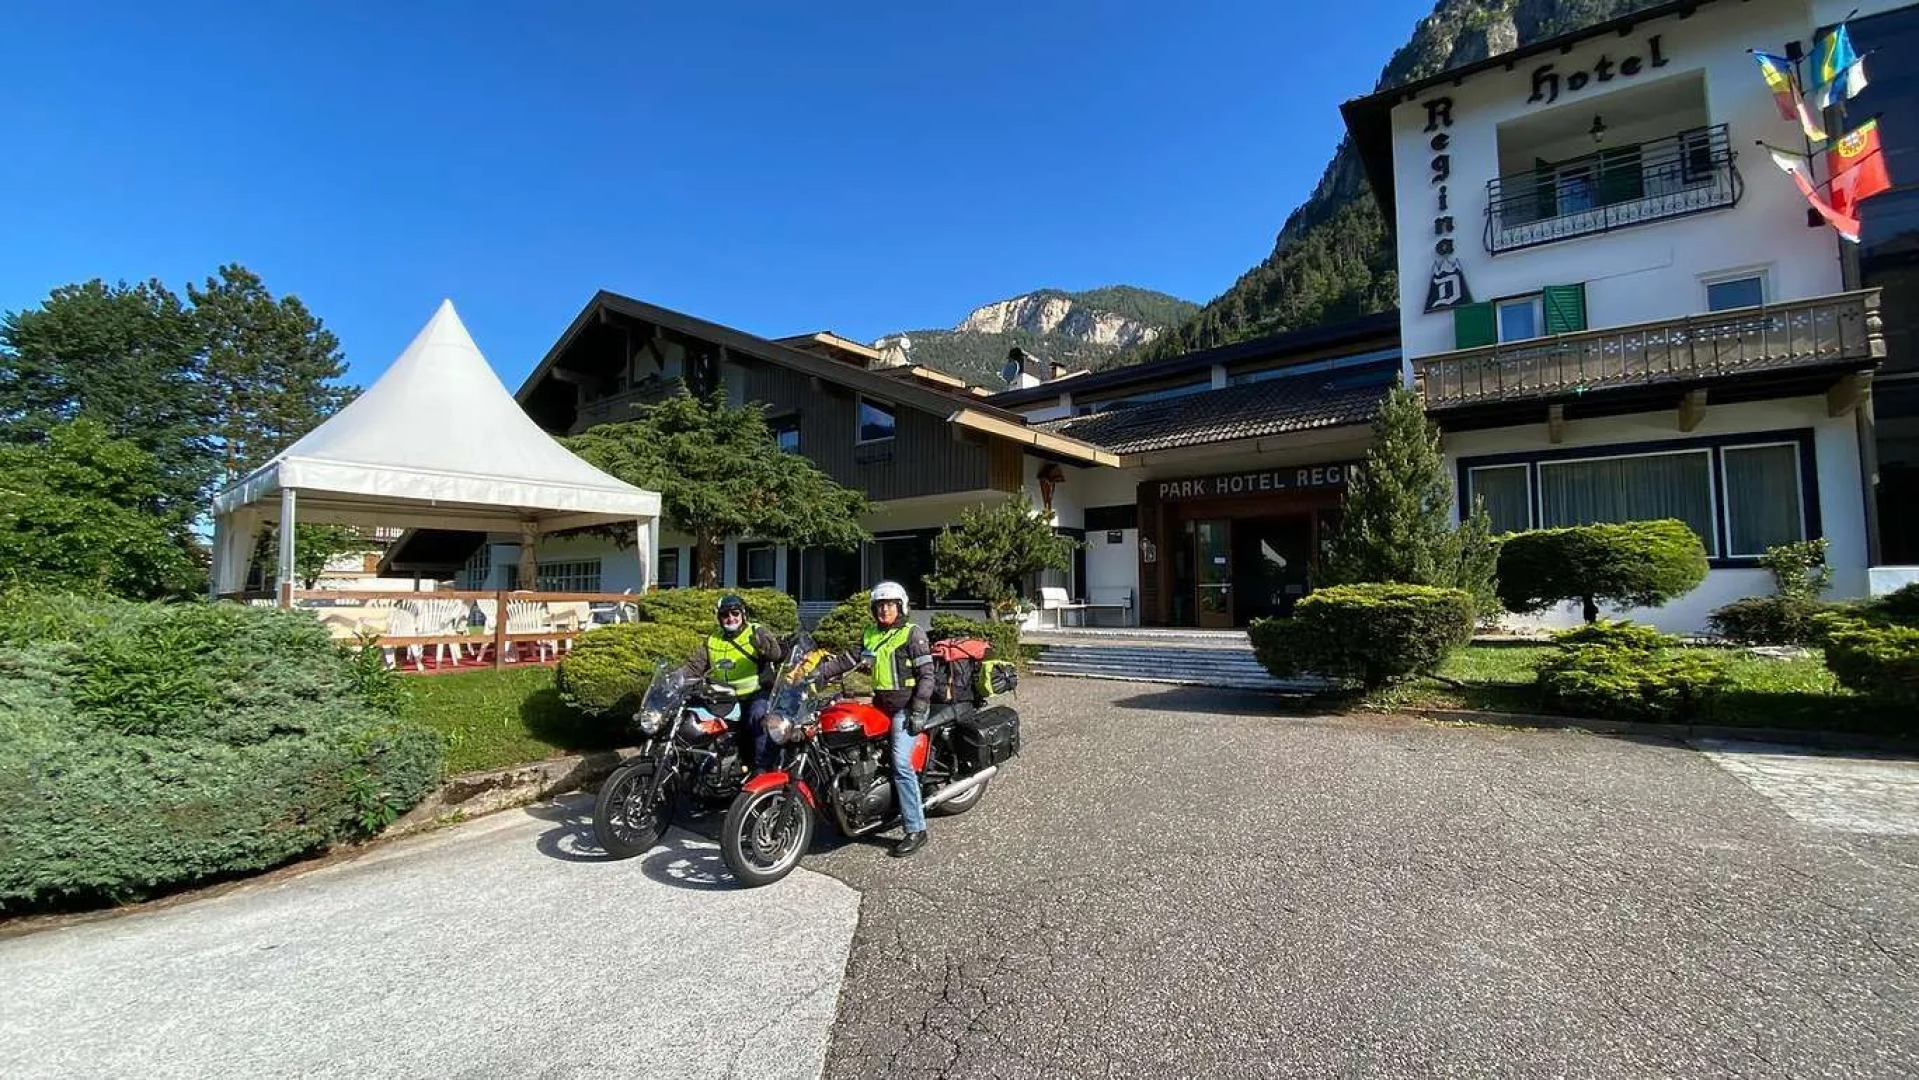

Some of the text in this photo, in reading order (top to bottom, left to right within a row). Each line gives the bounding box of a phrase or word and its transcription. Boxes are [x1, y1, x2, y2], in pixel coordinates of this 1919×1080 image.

[1526, 34, 1670, 104] Hotel
[1422, 96, 1455, 256] Regina
[1159, 464, 1367, 499] PARK HOTEL REGIN
